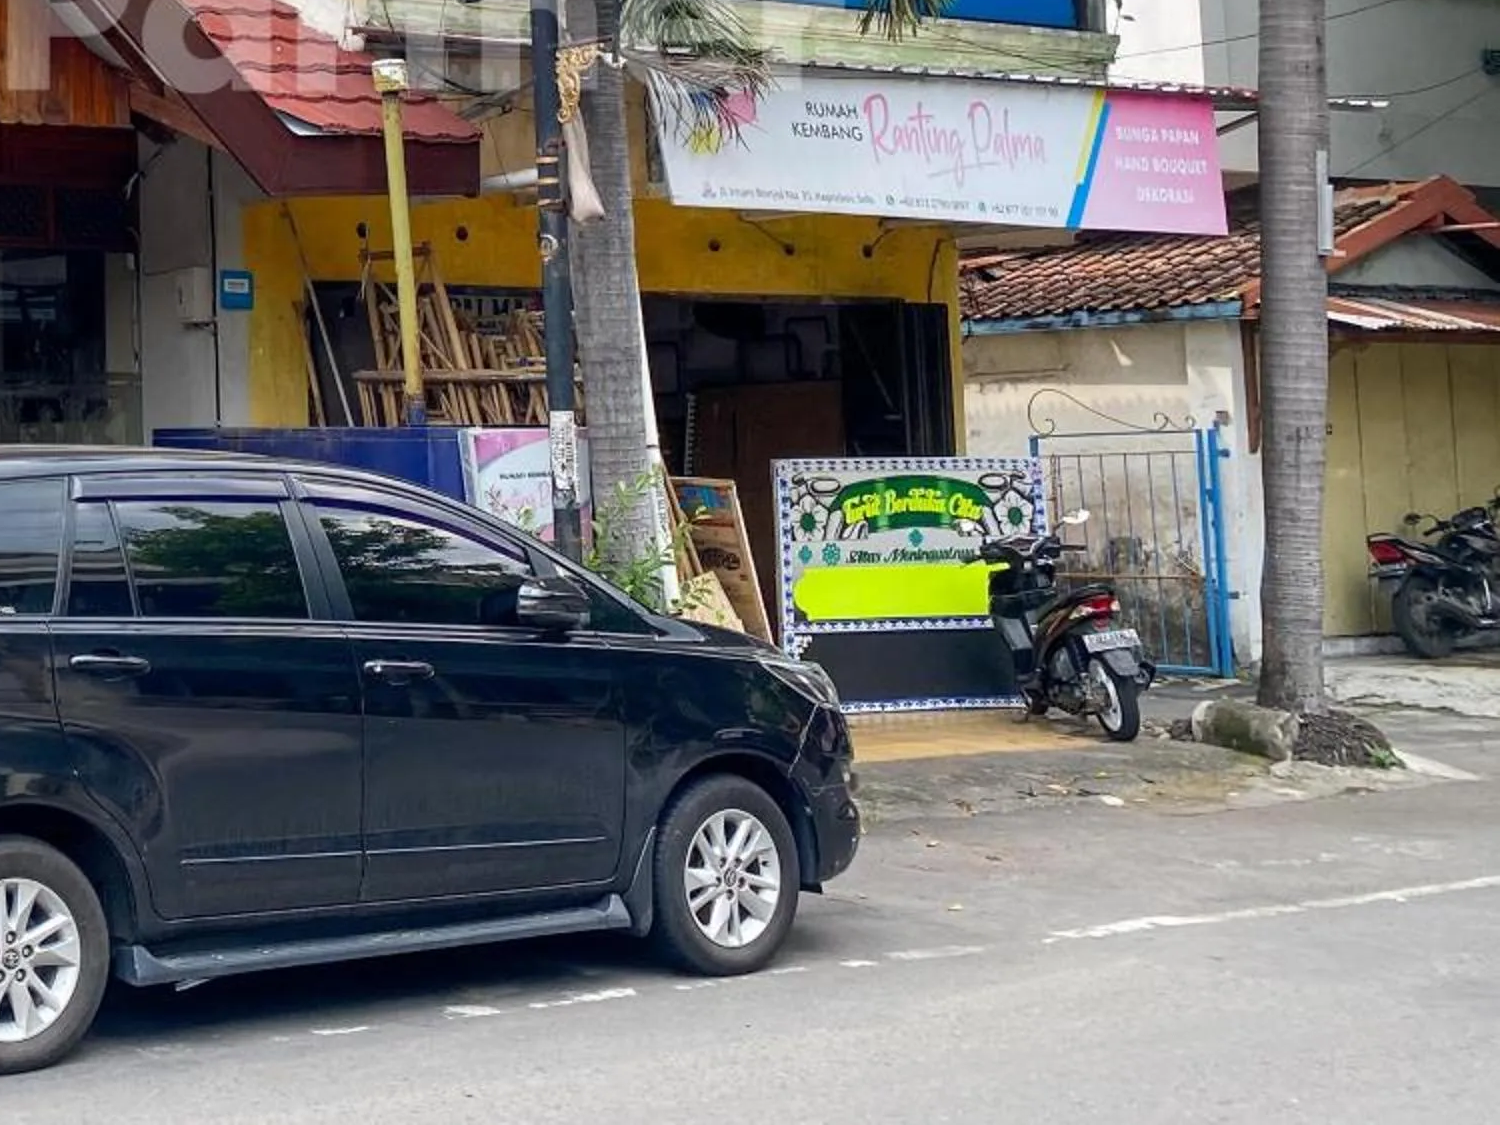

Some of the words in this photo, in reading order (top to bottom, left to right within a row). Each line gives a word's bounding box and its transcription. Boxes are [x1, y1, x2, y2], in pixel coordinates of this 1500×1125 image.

[804, 100, 860, 120] RUMAH
[790, 121, 864, 142] KEMBANG
[863, 93, 967, 189] Ranting
[967, 100, 1047, 171] Palma
